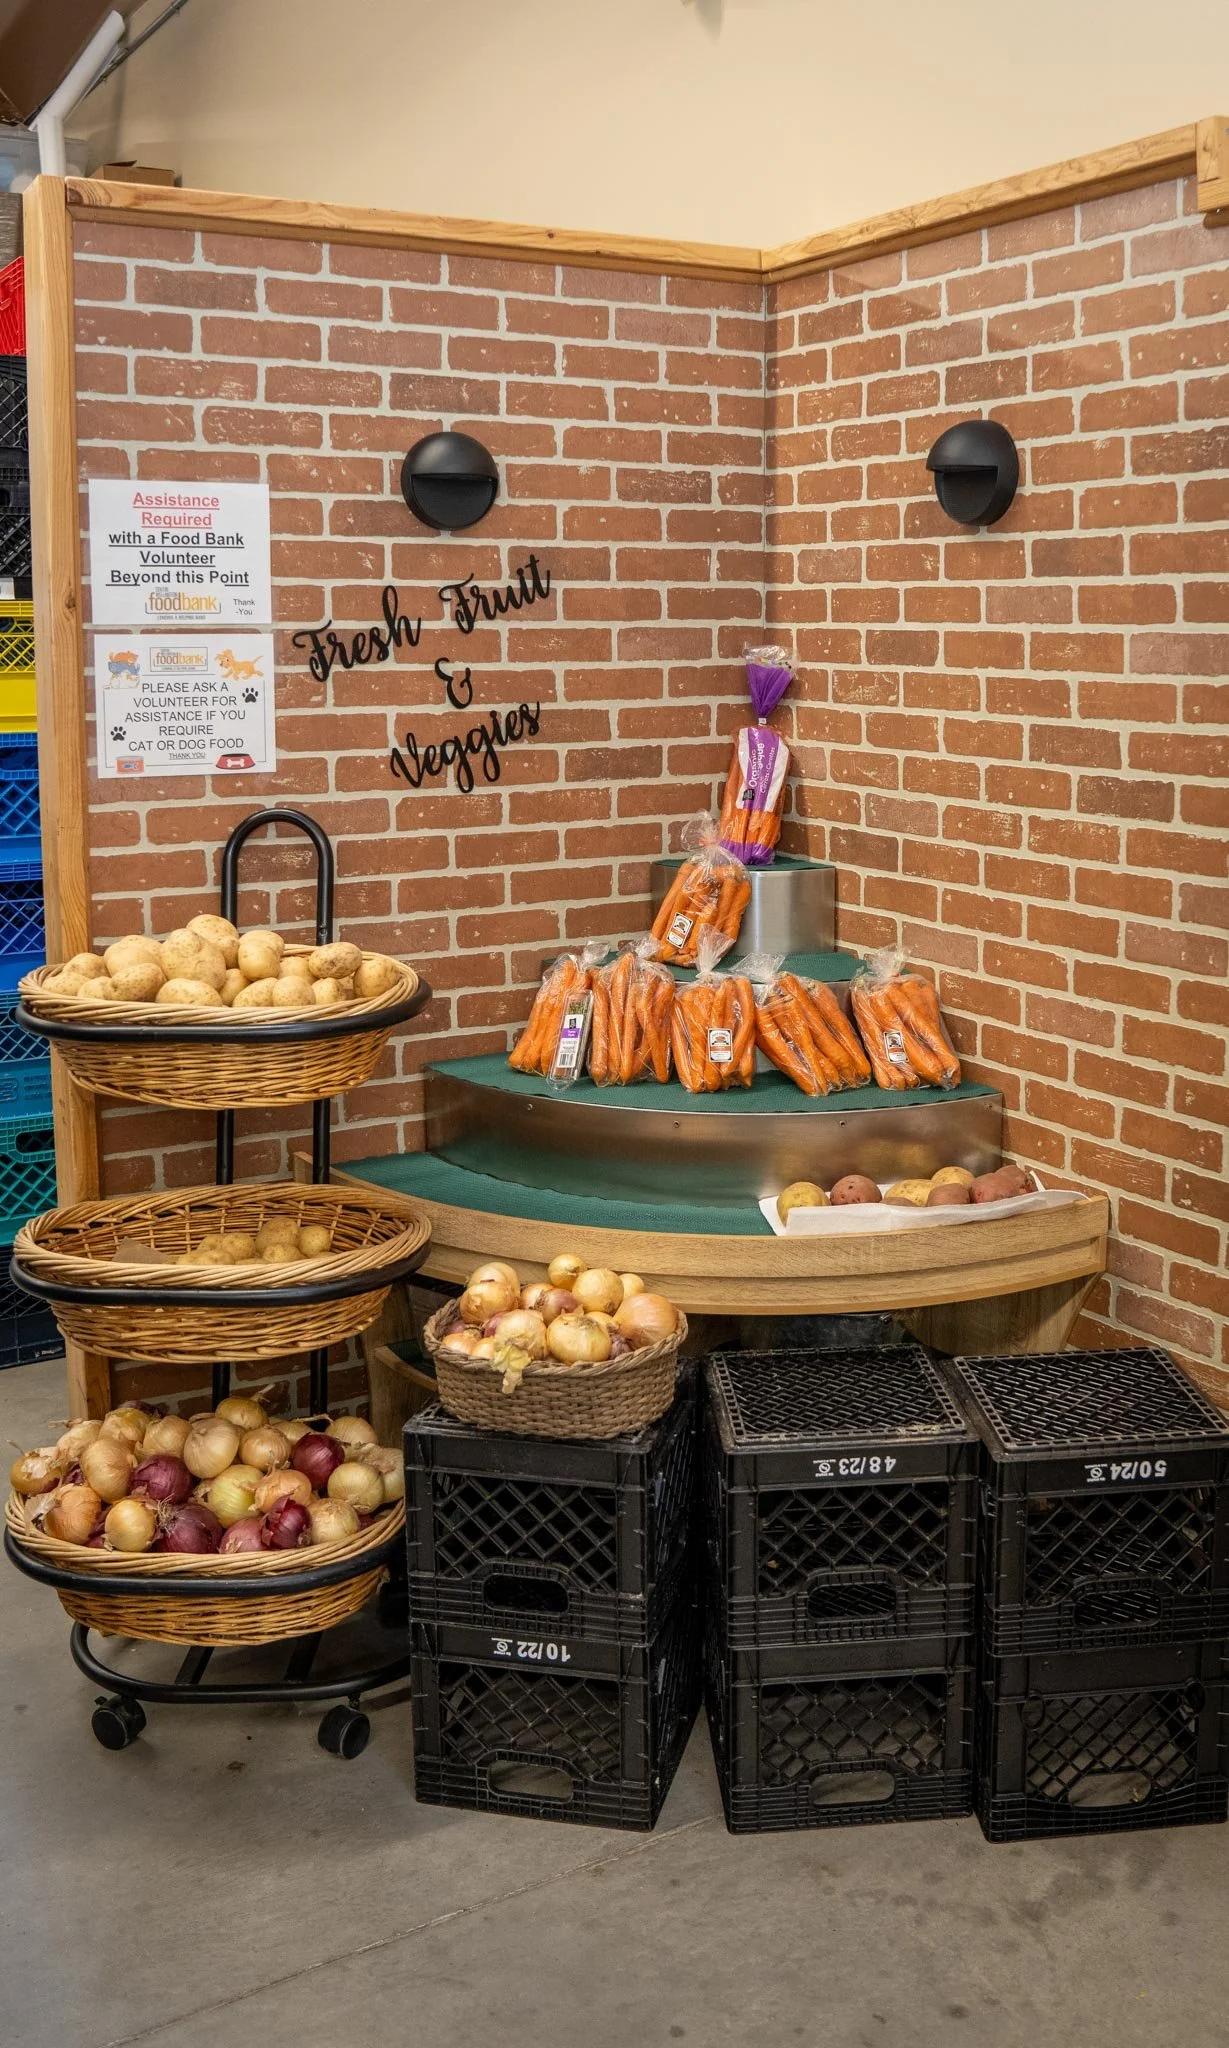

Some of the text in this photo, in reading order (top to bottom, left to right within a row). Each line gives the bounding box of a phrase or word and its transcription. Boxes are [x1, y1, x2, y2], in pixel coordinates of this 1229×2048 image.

[133, 492, 220, 507] Assistance
[141, 512, 212, 527] Required
[109, 531, 244, 546] with a Food Bank
[139, 550, 216, 564] Volunteer
[110, 570, 249, 585] Beyond this Point
[148, 592, 218, 611] foodbank
[233, 598, 255, 606] Thank
[292, 554, 551, 683] Fresh Fruit
[156, 652, 205, 665] foodbank
[142, 681, 229, 693] PLEASE ASK A
[434, 657, 473, 709] &
[133, 696, 237, 708] VOLUNTEER FOR
[125, 710, 246, 723] ASSISTANCE IF YOU
[159, 725, 214, 736] REQUIRE
[128, 738, 244, 752] CAT OR DOG FOOD
[390, 701, 540, 794] Veggies
[168, 752, 190, 760] THANK
[748, 749, 760, 788] Organic
